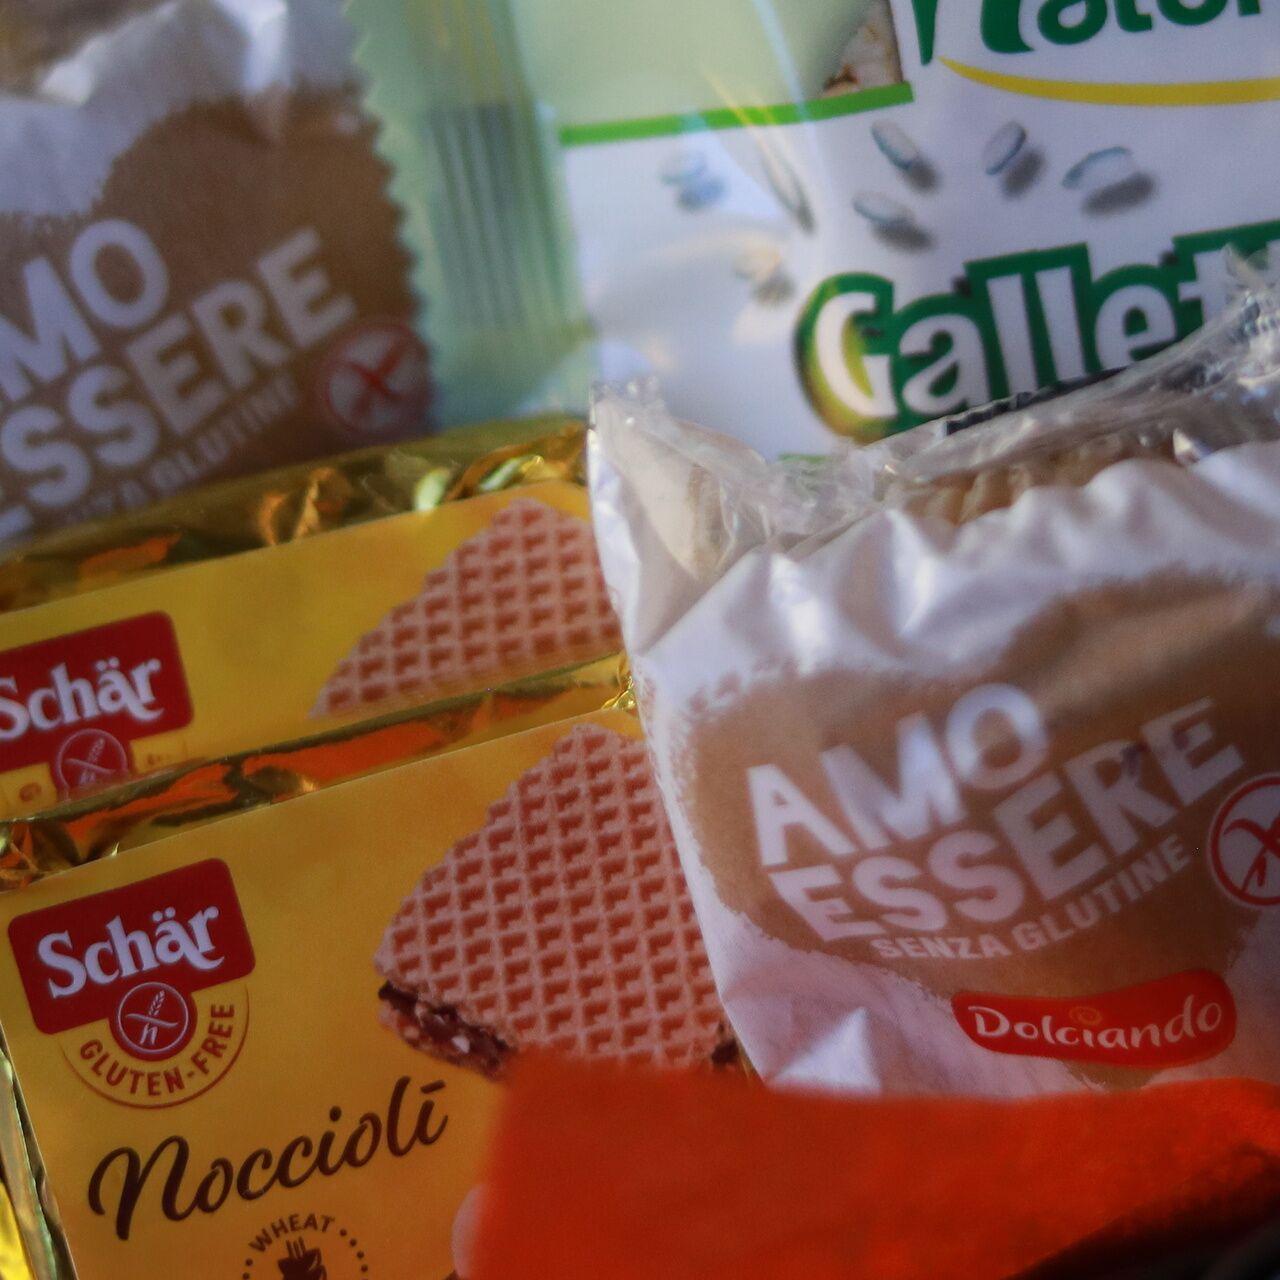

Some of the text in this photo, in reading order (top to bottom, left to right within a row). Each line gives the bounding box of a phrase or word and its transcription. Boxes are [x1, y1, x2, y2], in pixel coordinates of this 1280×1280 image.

[746, 682, 1050, 867] AMO
[768, 695, 1246, 944] ESSERE
[872, 832, 1193, 960] SENZA GLUTINE
[35, 905, 227, 1000] Schär
[79, 1002, 236, 1097] GLUTEN-FREE
[966, 994, 1223, 1052] Dolciando
[248, 1213, 337, 1254] WHEAT
